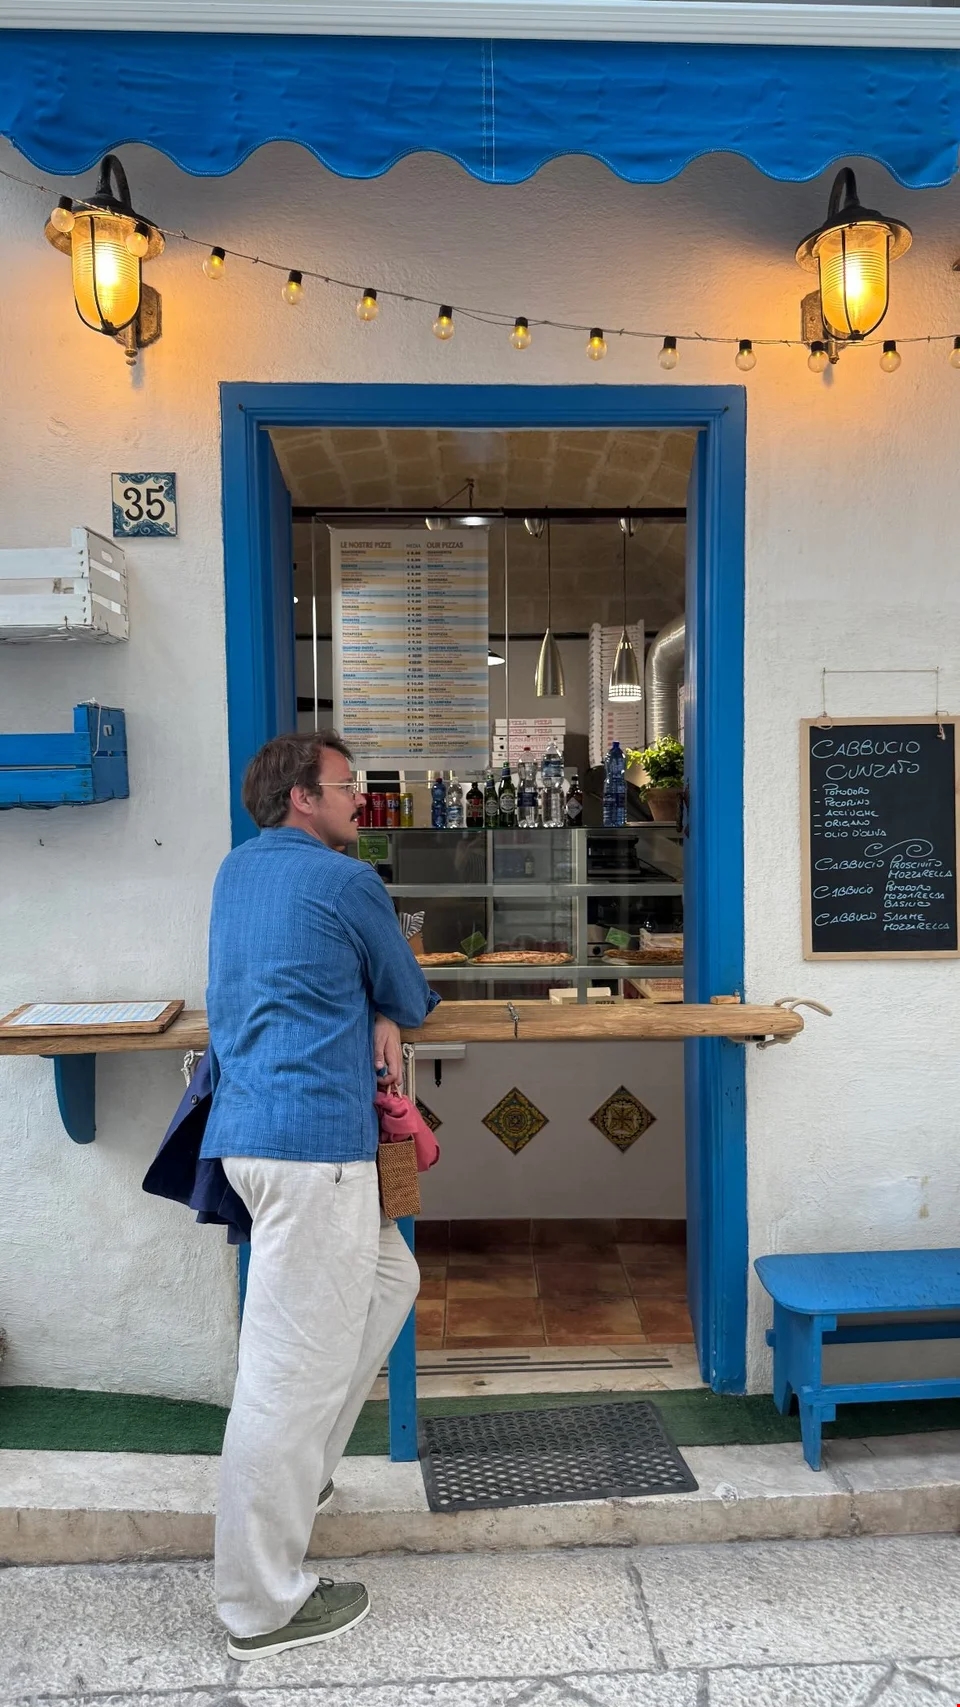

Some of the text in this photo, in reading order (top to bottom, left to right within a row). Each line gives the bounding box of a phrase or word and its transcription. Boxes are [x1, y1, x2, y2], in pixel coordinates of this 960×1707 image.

[123, 485, 165, 521] 35
[340, 541, 392, 549] LE NOSTRE PIZZE
[811, 739, 921, 759] CABBUCIO
[825, 759, 920, 780] CUNZATO
[822, 783, 870, 796] POMODORO
[824, 797, 870, 807] PECORINO
[825, 809, 879, 818] ACCIUGHE
[824, 819, 870, 828] ORIGANO
[824, 829, 849, 838] OLIO
[814, 857, 884, 871] CABBUCIO
[887, 869, 953, 879] MOZZARELLA
[885, 880, 931, 892] POMODORO
[814, 911, 926, 927] CABBUCIO SALAME
[883, 922, 950, 931] MOZZARELLA
